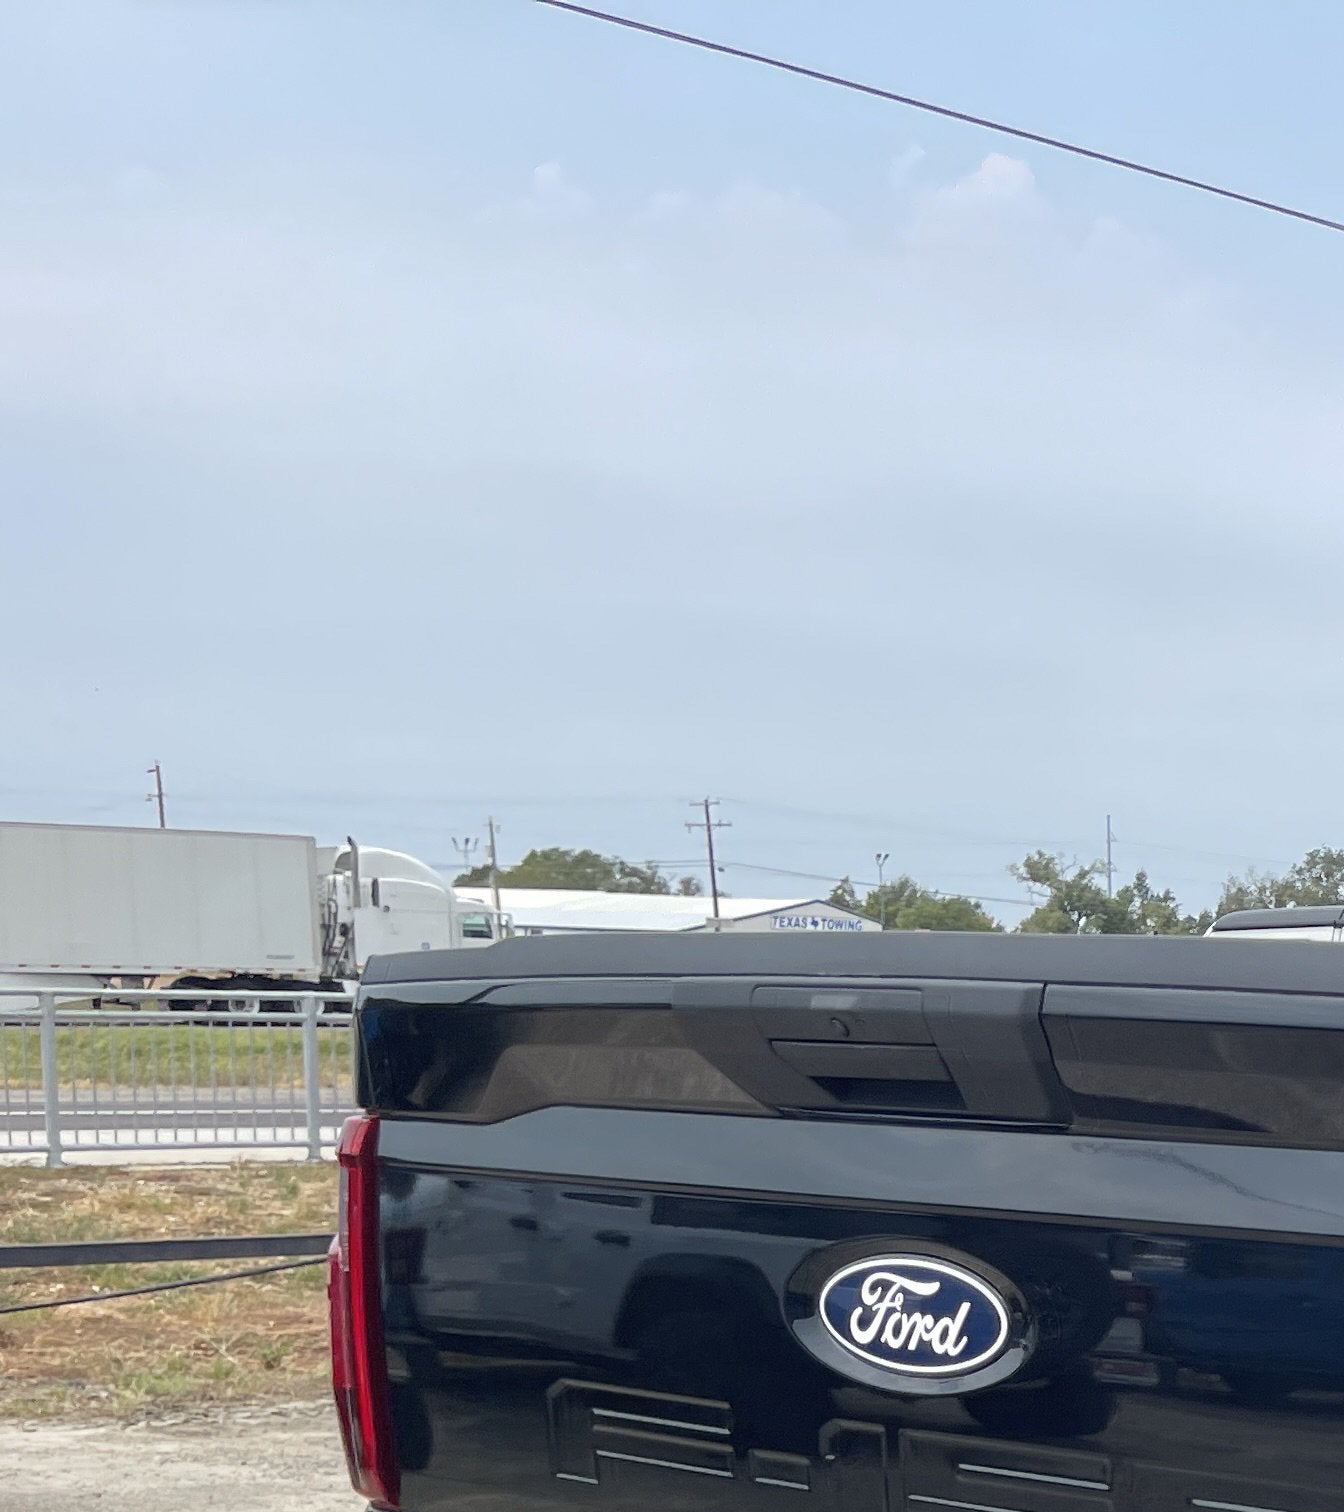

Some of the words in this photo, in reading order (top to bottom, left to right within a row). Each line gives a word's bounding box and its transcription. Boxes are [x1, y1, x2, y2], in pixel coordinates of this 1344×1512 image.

[772, 916, 808, 929] TEXAS
[821, 918, 863, 932] TOWING
[849, 1270, 971, 1358] Ford
